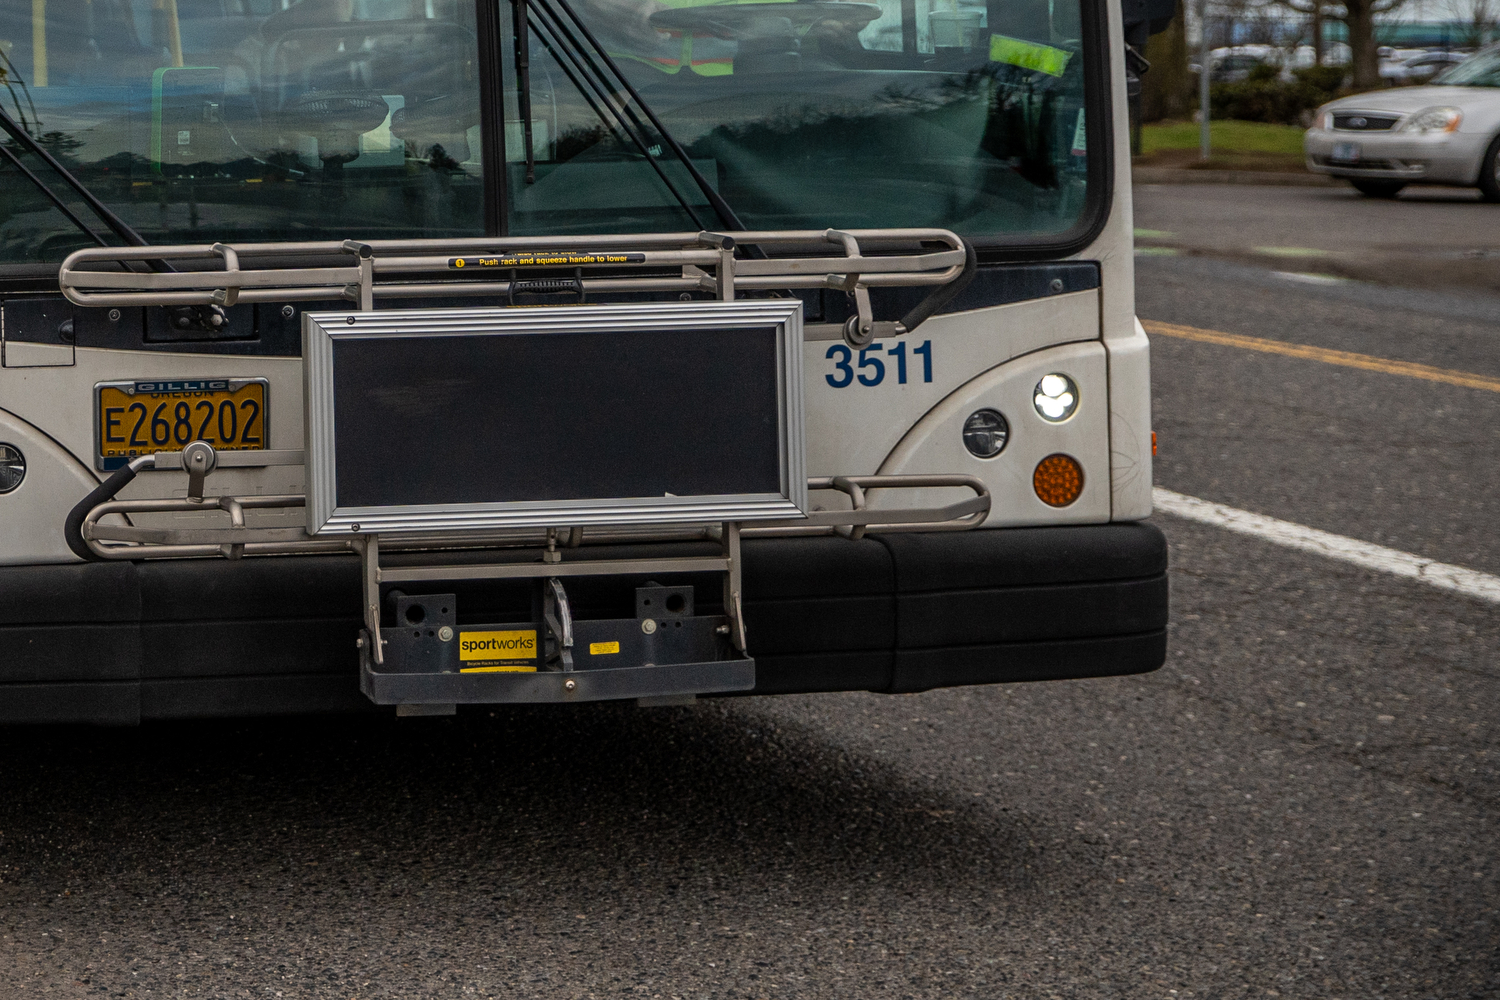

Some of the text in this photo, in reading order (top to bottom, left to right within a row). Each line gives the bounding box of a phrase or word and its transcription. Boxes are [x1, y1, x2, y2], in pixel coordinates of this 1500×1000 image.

[479, 258, 499, 266] Push
[501, 257, 517, 265] rack
[519, 257, 534, 265] and
[536, 256, 568, 266] squeeze
[569, 255, 595, 263] handle
[825, 340, 933, 389] 3511
[138, 381, 227, 392] GILLIG
[105, 399, 260, 447] E268202
